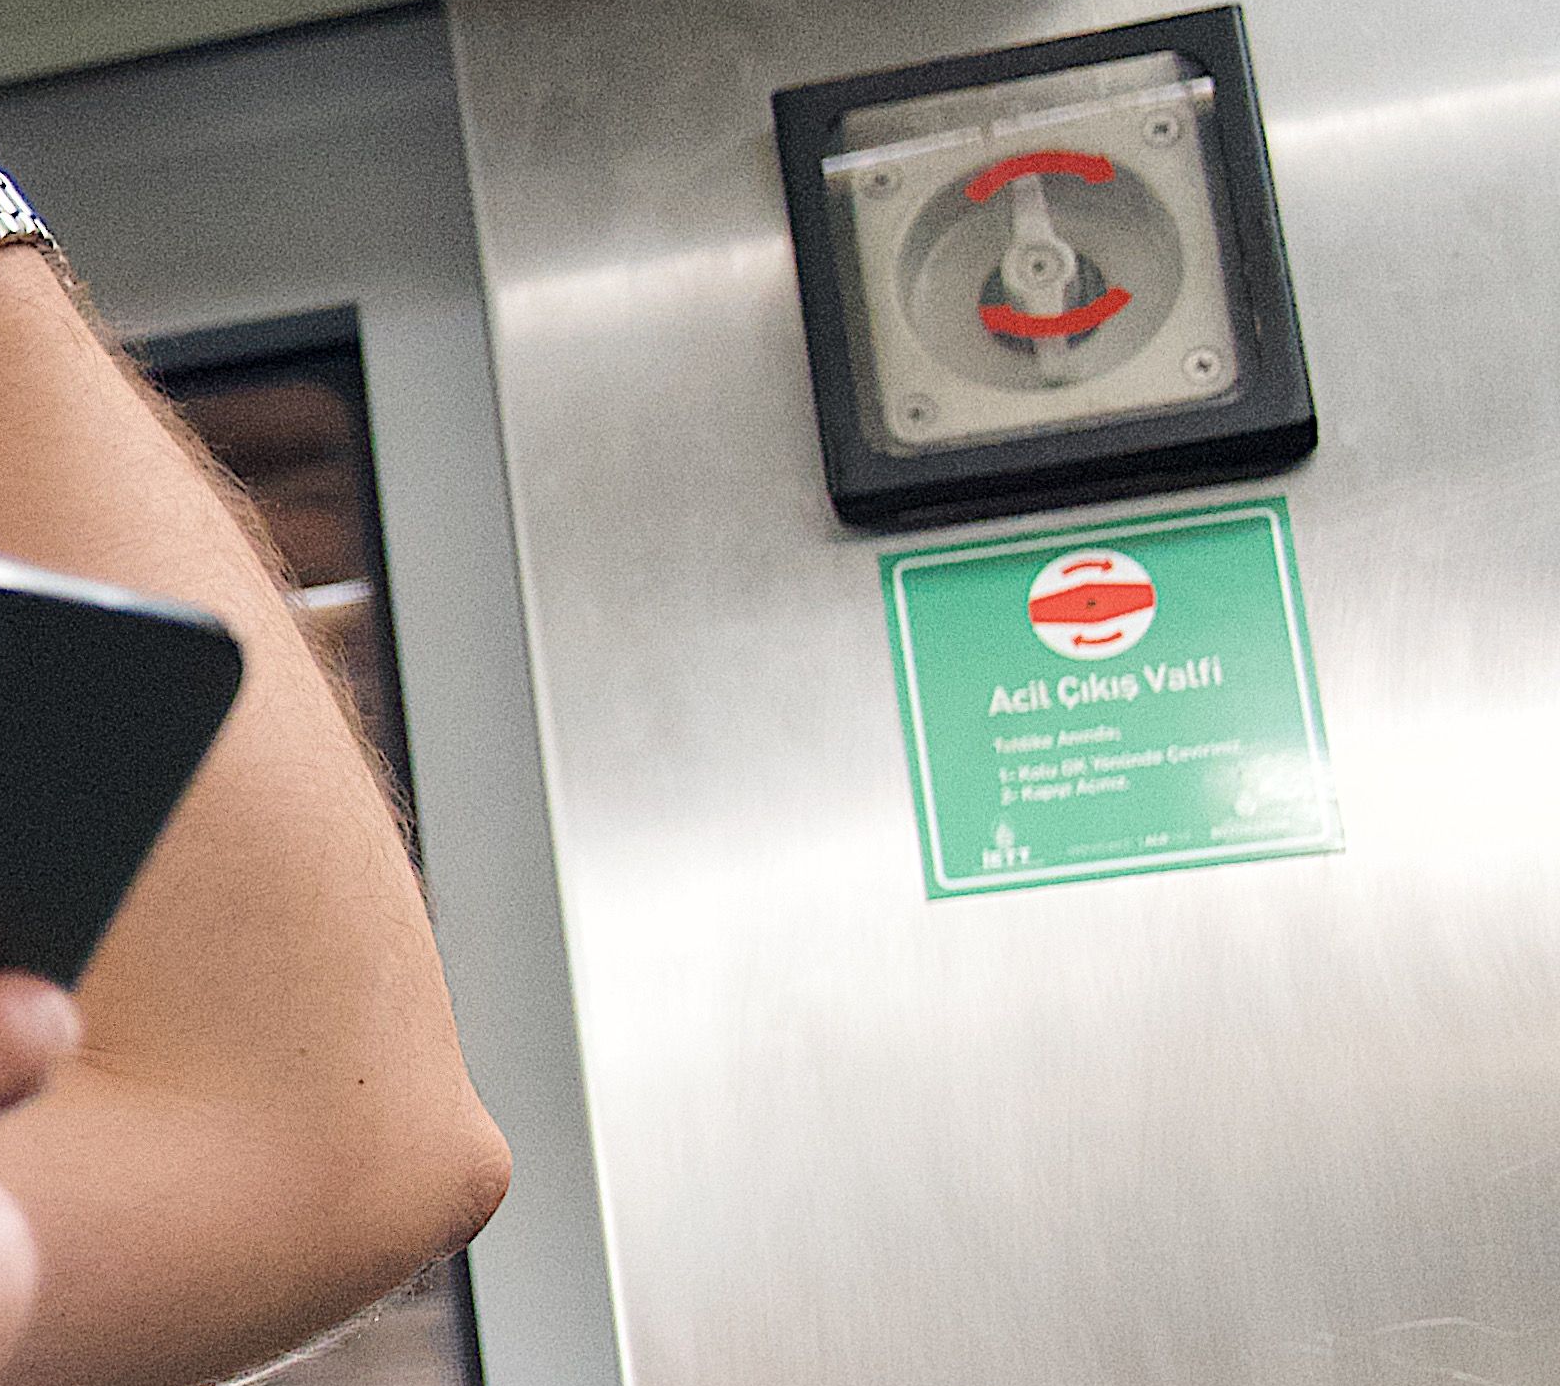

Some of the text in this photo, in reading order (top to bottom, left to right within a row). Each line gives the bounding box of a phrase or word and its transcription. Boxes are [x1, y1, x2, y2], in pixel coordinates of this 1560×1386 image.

[989, 655, 1223, 717] Acil Çıkış Valfi
